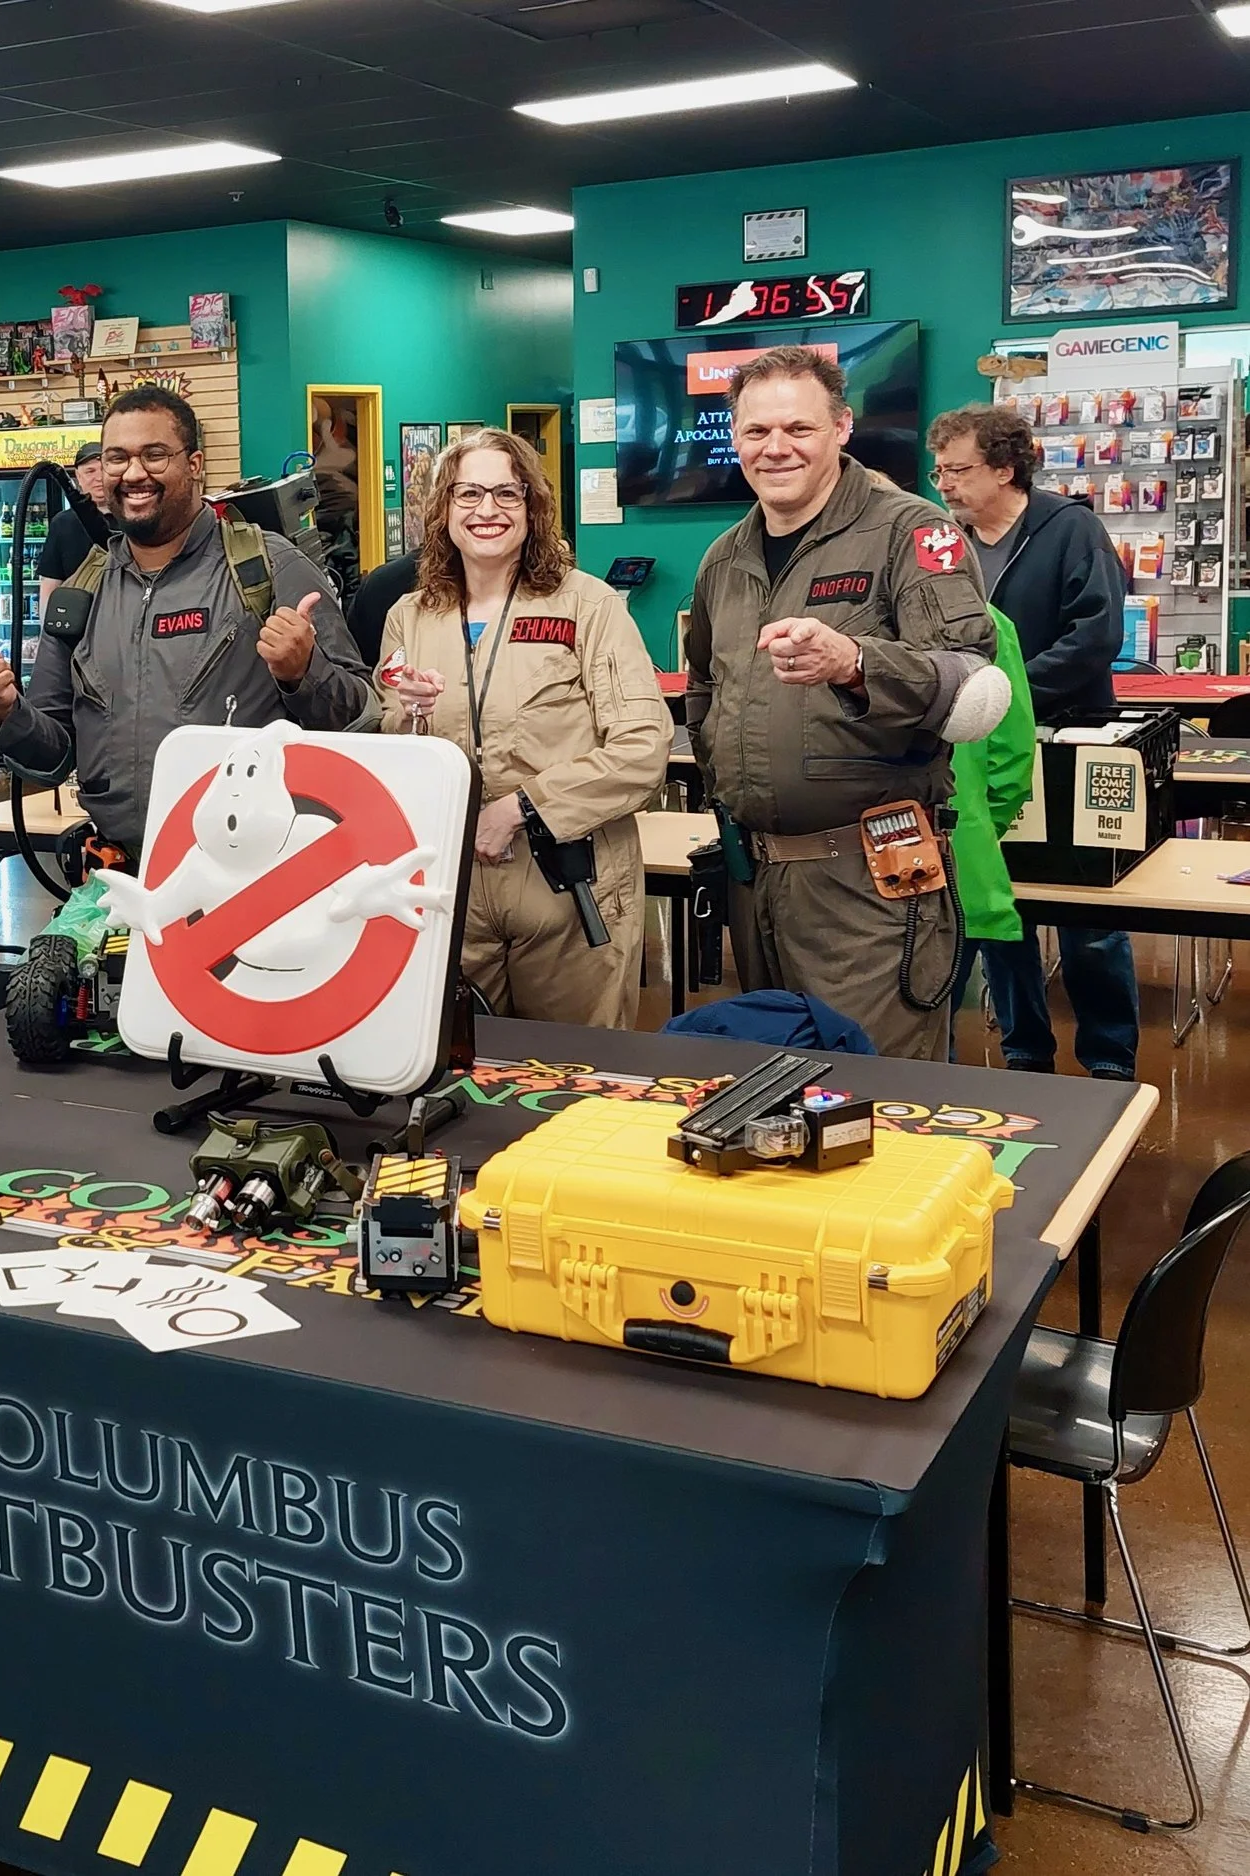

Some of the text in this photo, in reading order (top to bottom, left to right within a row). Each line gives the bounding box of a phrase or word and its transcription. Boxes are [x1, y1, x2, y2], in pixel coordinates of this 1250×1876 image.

[811, 576, 867, 598] ONOFRIO
[158, 612, 203, 632] EVANS
[1091, 765, 1131, 779] FREE
[1091, 777, 1131, 789] COMIC
[1091, 787, 1130, 799] BOOK
[1098, 797, 1124, 808] DAY
[1097, 814, 1123, 830] Red
[1097, 831, 1122, 841] Mature
